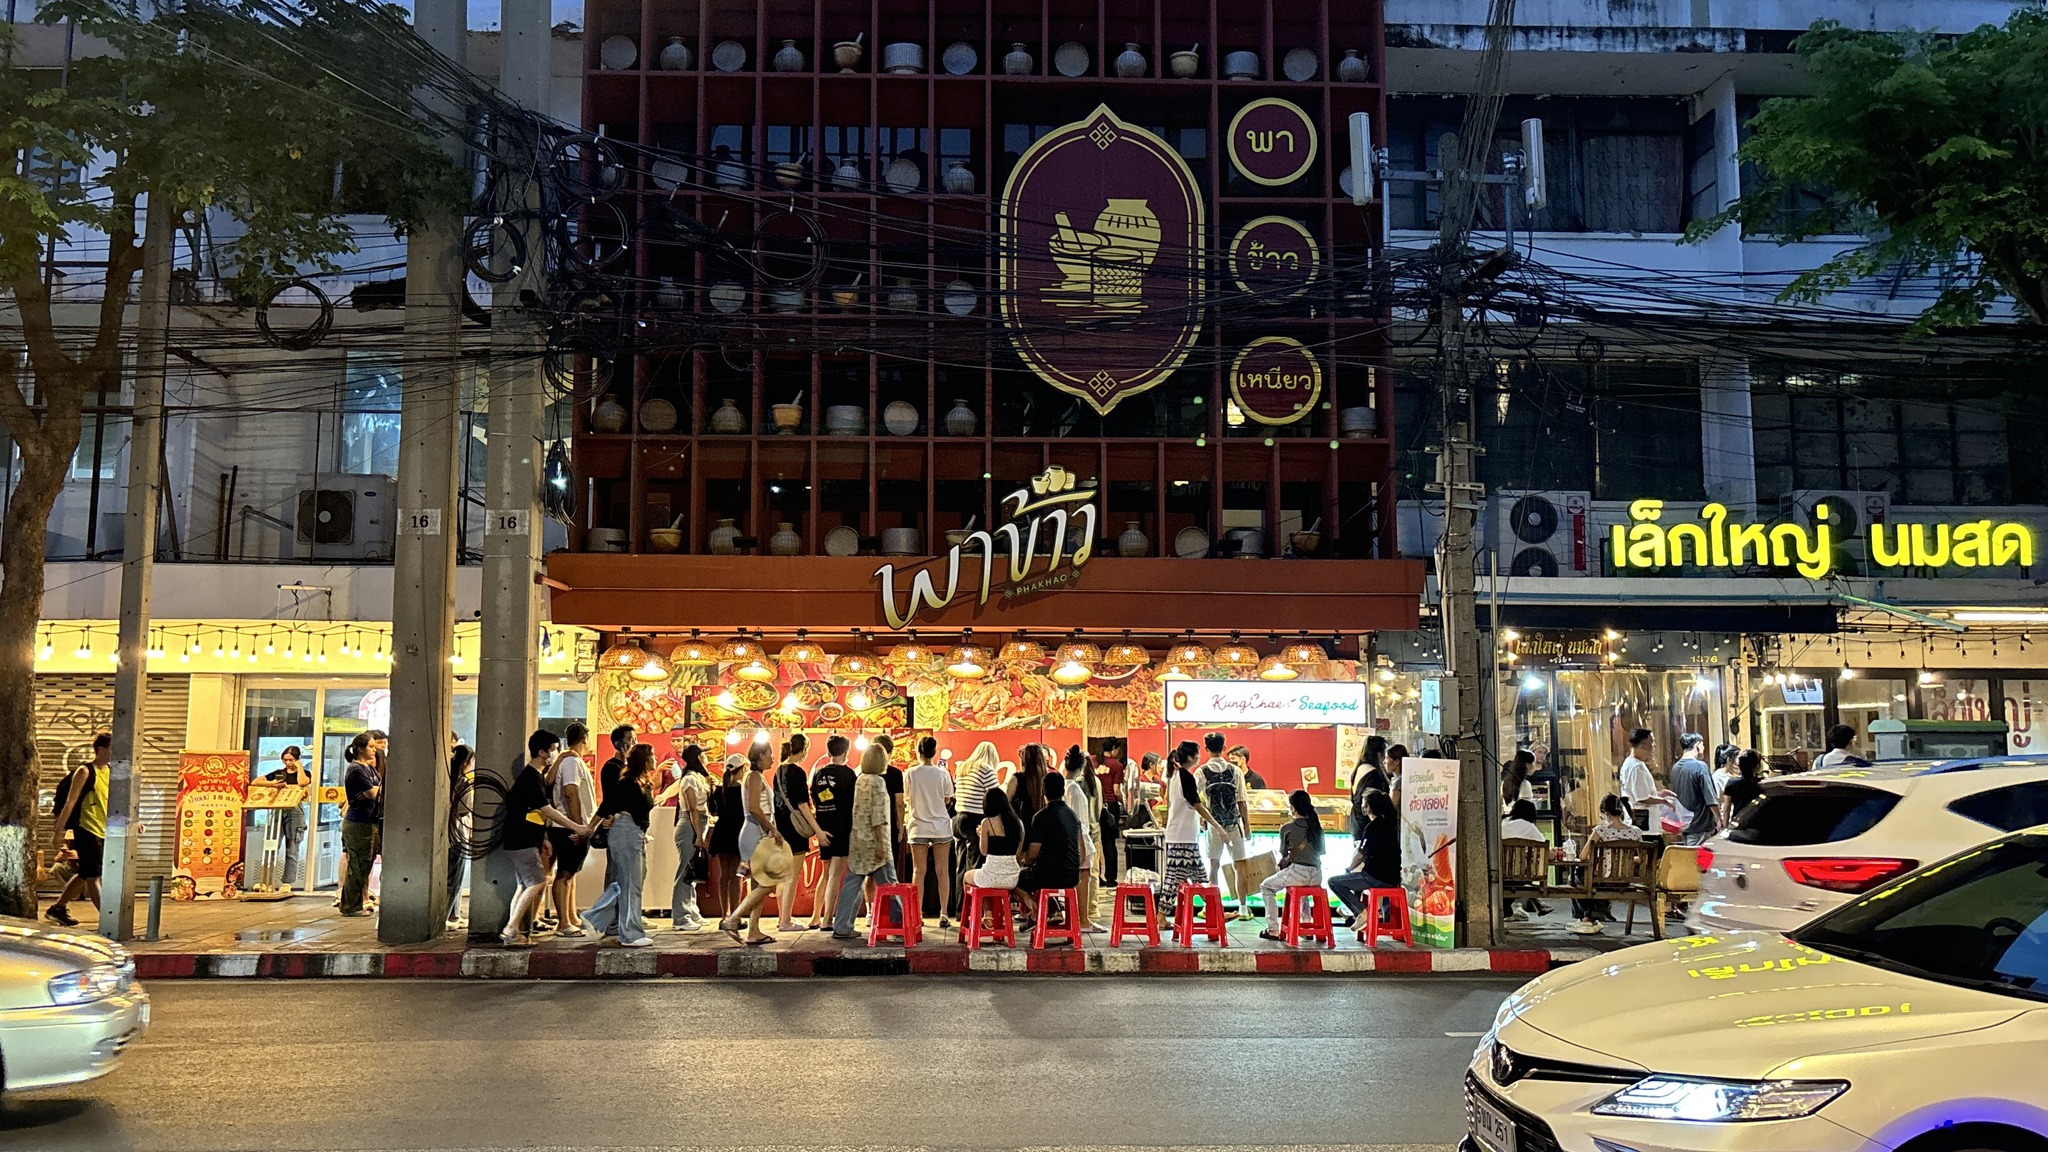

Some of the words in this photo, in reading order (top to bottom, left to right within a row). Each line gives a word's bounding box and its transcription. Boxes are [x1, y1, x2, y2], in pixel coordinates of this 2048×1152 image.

[1246, 130, 1294, 153] พา
[1247, 240, 1299, 270] ข้าว
[1240, 366, 1312, 390] เหนียว
[411, 515, 429, 533] 16
[498, 516, 517, 535] 16
[1612, 499, 1832, 579] เล็กใหญ่
[1871, 519, 2033, 567] นมสด
[873, 488, 1098, 630] พาข้าว
[1016, 574, 1069, 596] PHAKHAO
[1298, 695, 1359, 716] Seafood
[1408, 794, 1450, 812] ต้องลอง!
